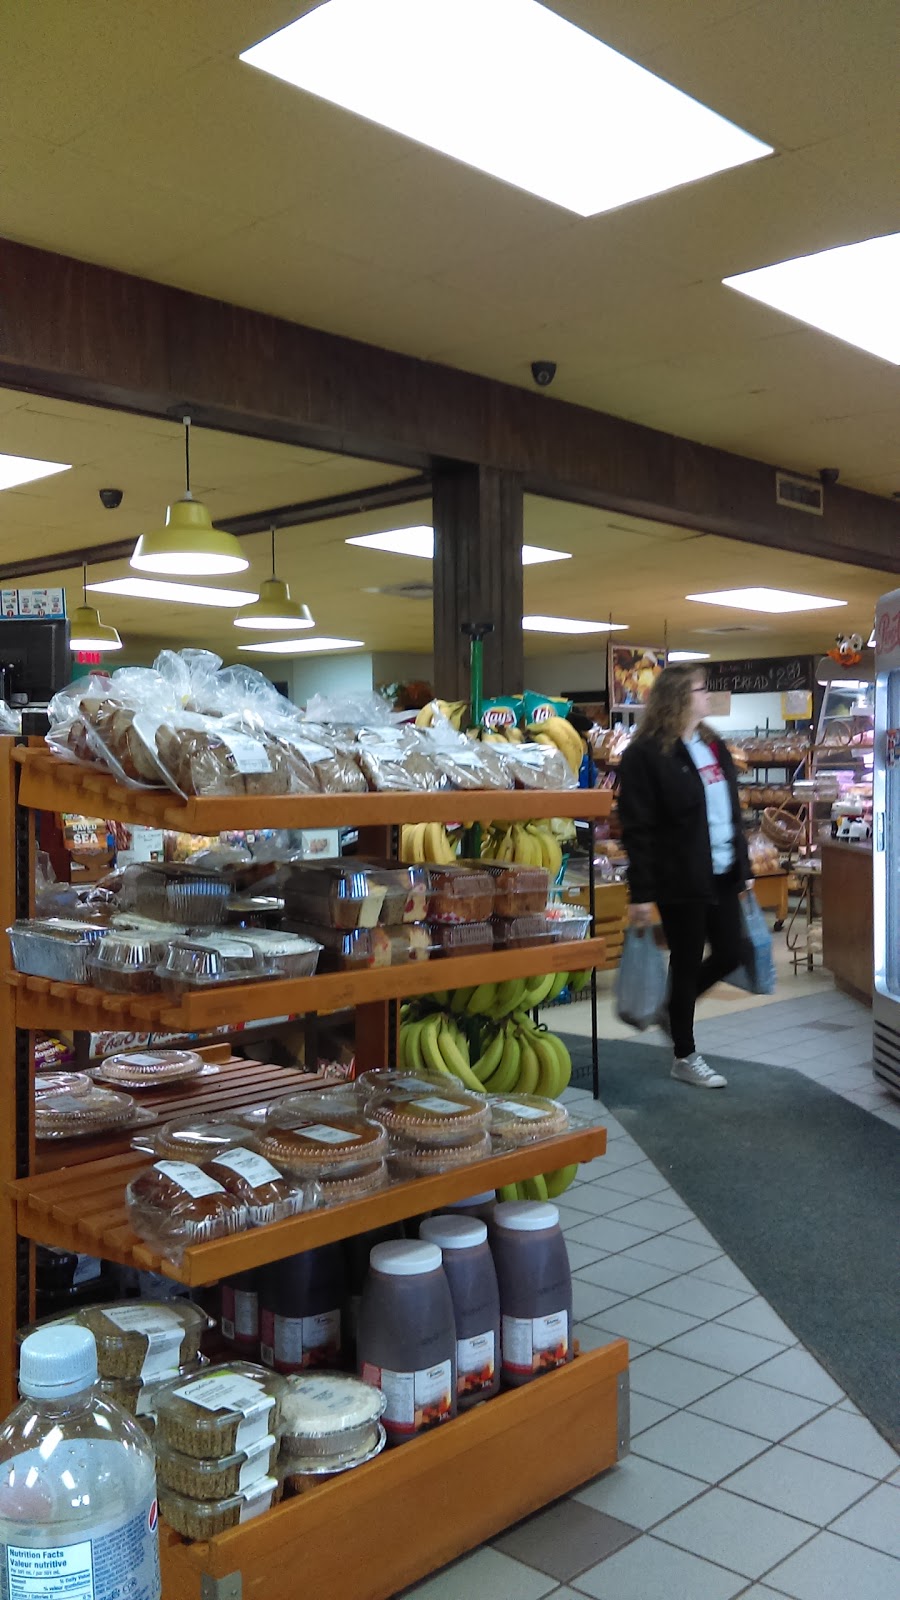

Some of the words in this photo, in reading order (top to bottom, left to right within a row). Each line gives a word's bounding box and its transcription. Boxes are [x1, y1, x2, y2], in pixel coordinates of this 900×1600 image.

[732, 674, 769, 690] BREAD
[72, 823, 97, 831] SAVED
[74, 833, 99, 844] SEA
[9, 1549, 41, 1558] Nutrition
[43, 1550, 64, 1559] Facts
[10, 1559, 32, 1568] Valeur
[34, 1560, 67, 1569] nutritive
